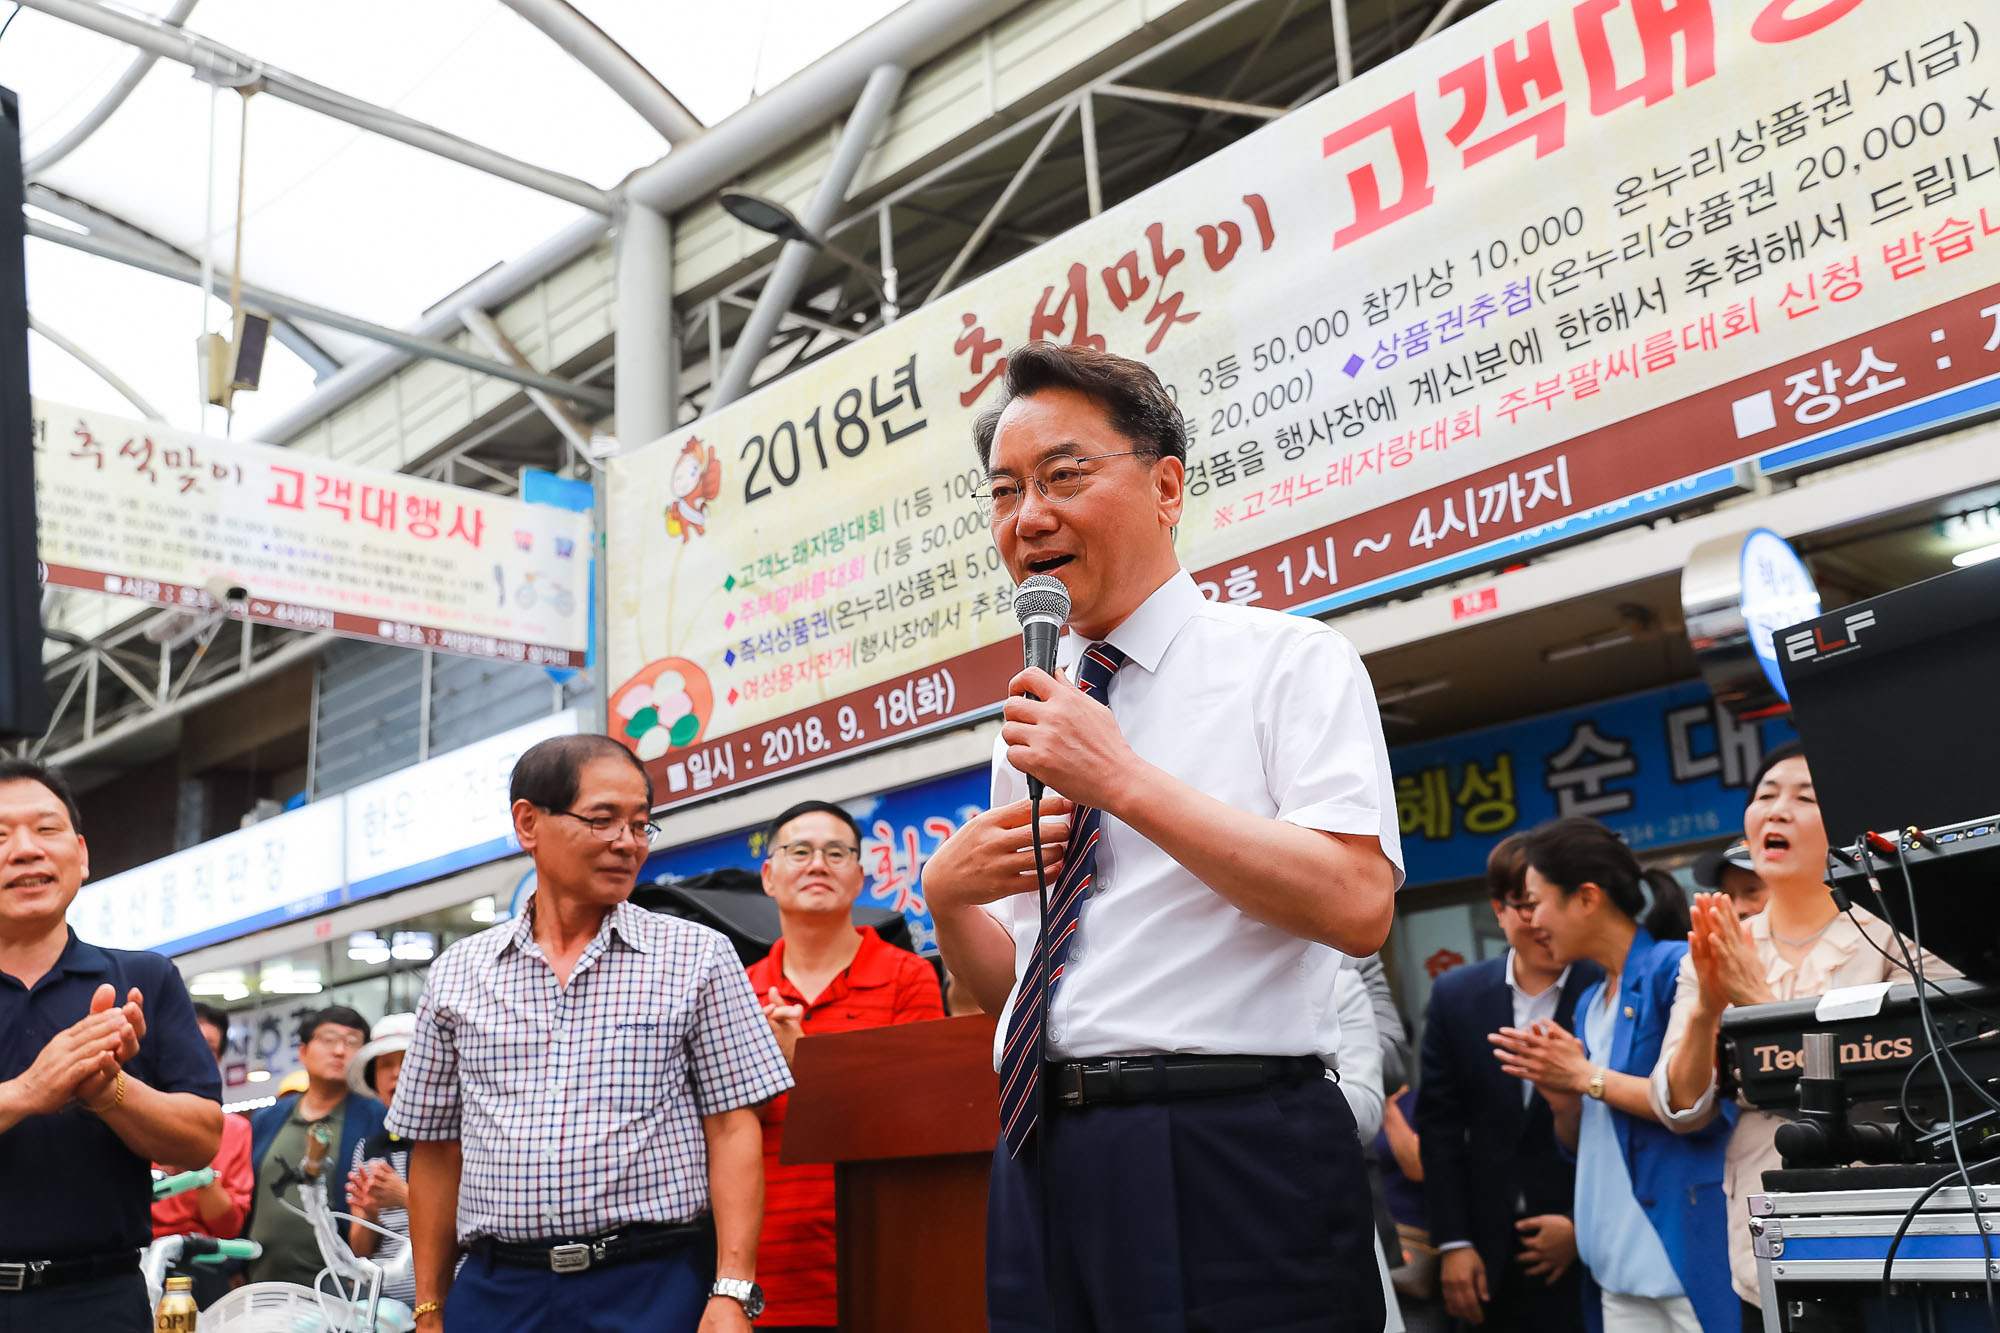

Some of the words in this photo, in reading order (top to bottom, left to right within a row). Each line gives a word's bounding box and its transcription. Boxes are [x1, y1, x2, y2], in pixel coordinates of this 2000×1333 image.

[739, 506, 886, 588] 고객노래자랑대회
[893, 486, 933, 528] (1등
[943, 468, 980, 503] 100
[1197, 353, 1241, 396] 3등
[1252, 309, 1350, 373] 50,000
[1361, 259, 1454, 328] 참가상
[1469, 205, 1585, 279] 10,000
[1612, 79, 1854, 219] 온누리상품권
[1873, 20, 1980, 96] 지급)
[740, 354, 928, 504] 2018년
[1323, 0, 1865, 251] 고객대
[740, 554, 867, 626] 주부팔씨름대회
[873, 536, 913, 576] (1등
[1210, 368, 1314, 437] 20,000)
[1796, 100, 1947, 193] 20,000
[966, 545, 1000, 580] 5,0
[1184, 440, 1265, 497] 경품을
[1274, 387, 1398, 461] 행사장에
[1408, 328, 1544, 409] 계신분에
[1555, 276, 1668, 354] 한해서
[1684, 202, 1850, 299] 추첨해서
[1783, 346, 1906, 424] 장소
[70, 419, 243, 495] 추석맞이
[266, 464, 485, 549] 고객대행사
[970, 582, 1014, 622] 추첨
[1496, 297, 1760, 425] 주부팔씨름대회
[1777, 256, 1865, 321] 신청
[1276, 537, 1338, 597] 1시
[1409, 455, 1572, 549] 4시까지
[1785, 610, 1876, 662] ELF
[687, 743, 735, 792] 일시
[762, 717, 831, 767] 2018.
[838, 702, 864, 742] 9.
[873, 668, 955, 729] 18(화)
[1396, 752, 1517, 840] 혜성
[1754, 1034, 1912, 1072] Tenics
